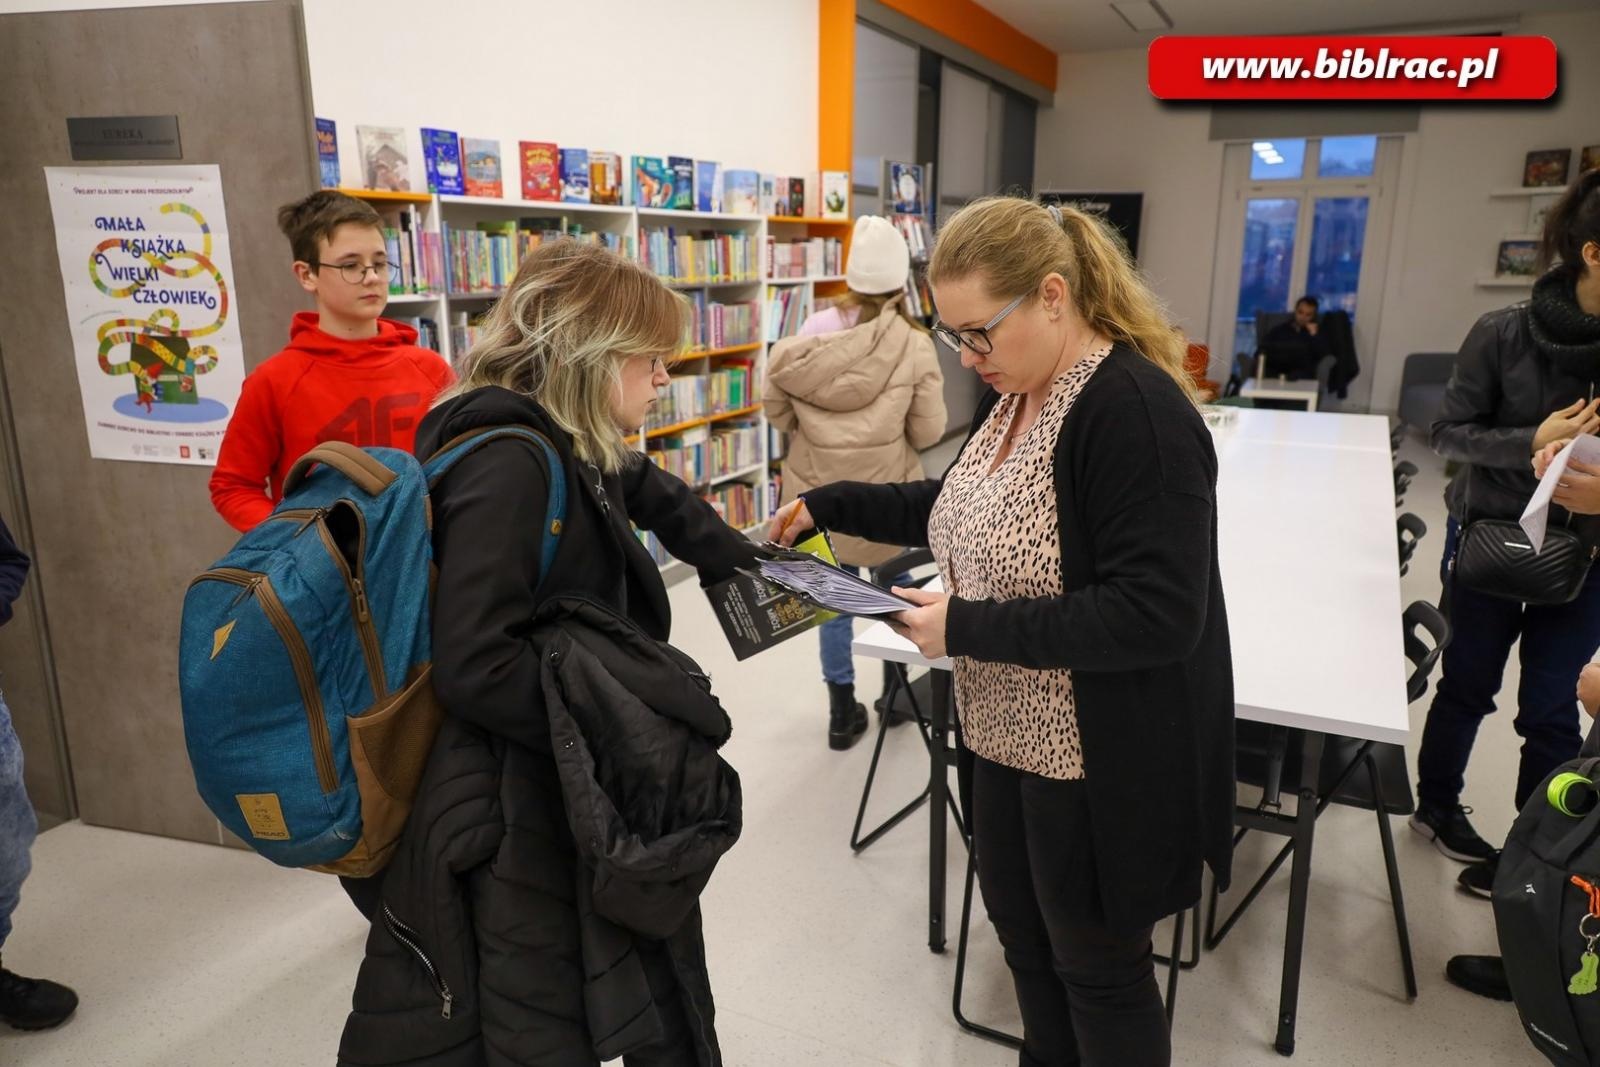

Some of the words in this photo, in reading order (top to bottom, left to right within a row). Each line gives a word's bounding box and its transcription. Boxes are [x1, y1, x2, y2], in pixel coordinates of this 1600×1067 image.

[95, 217, 146, 232] MAŁA
[121, 234, 187, 259] KSIĄŻKA
[95, 253, 159, 287] WIELKI
[133, 289, 217, 310] CZŁOWIEK
